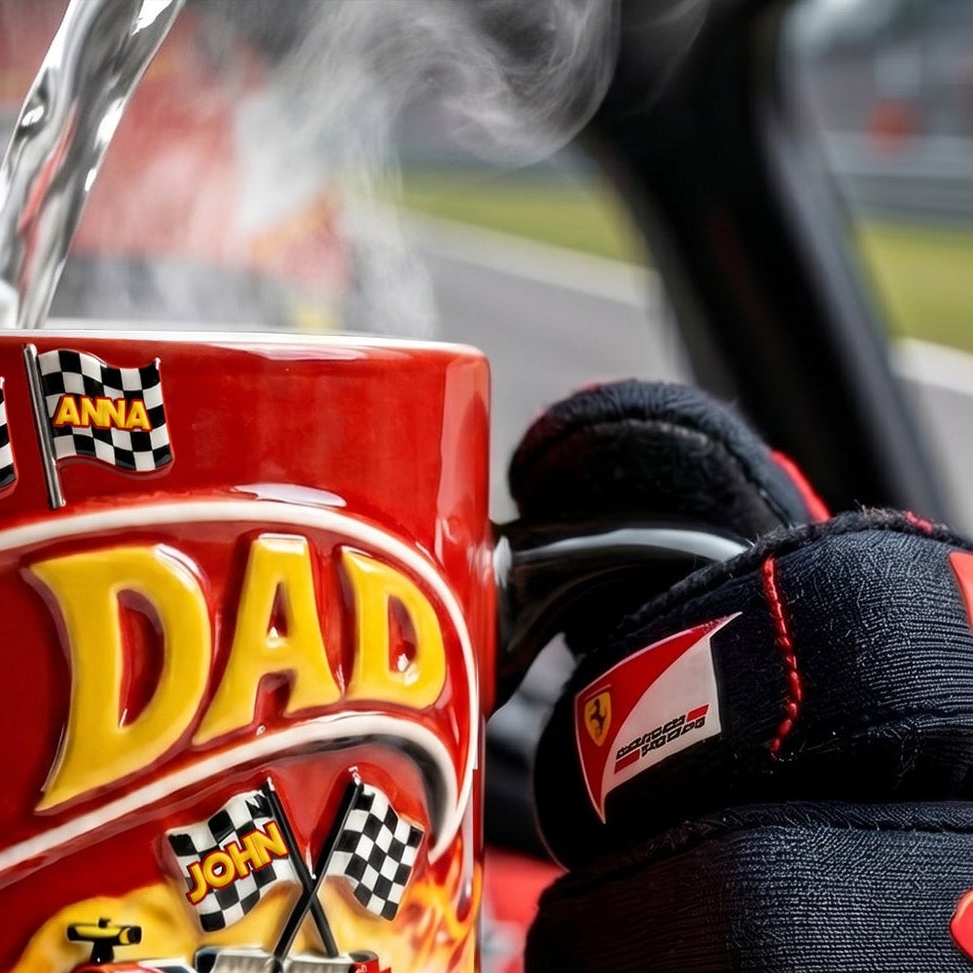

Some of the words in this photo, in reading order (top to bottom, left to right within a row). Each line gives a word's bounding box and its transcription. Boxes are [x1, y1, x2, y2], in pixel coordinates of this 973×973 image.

[53, 395, 152, 431] ANNA
[29, 533, 447, 812] DAD
[185, 819, 290, 905] JOHN
